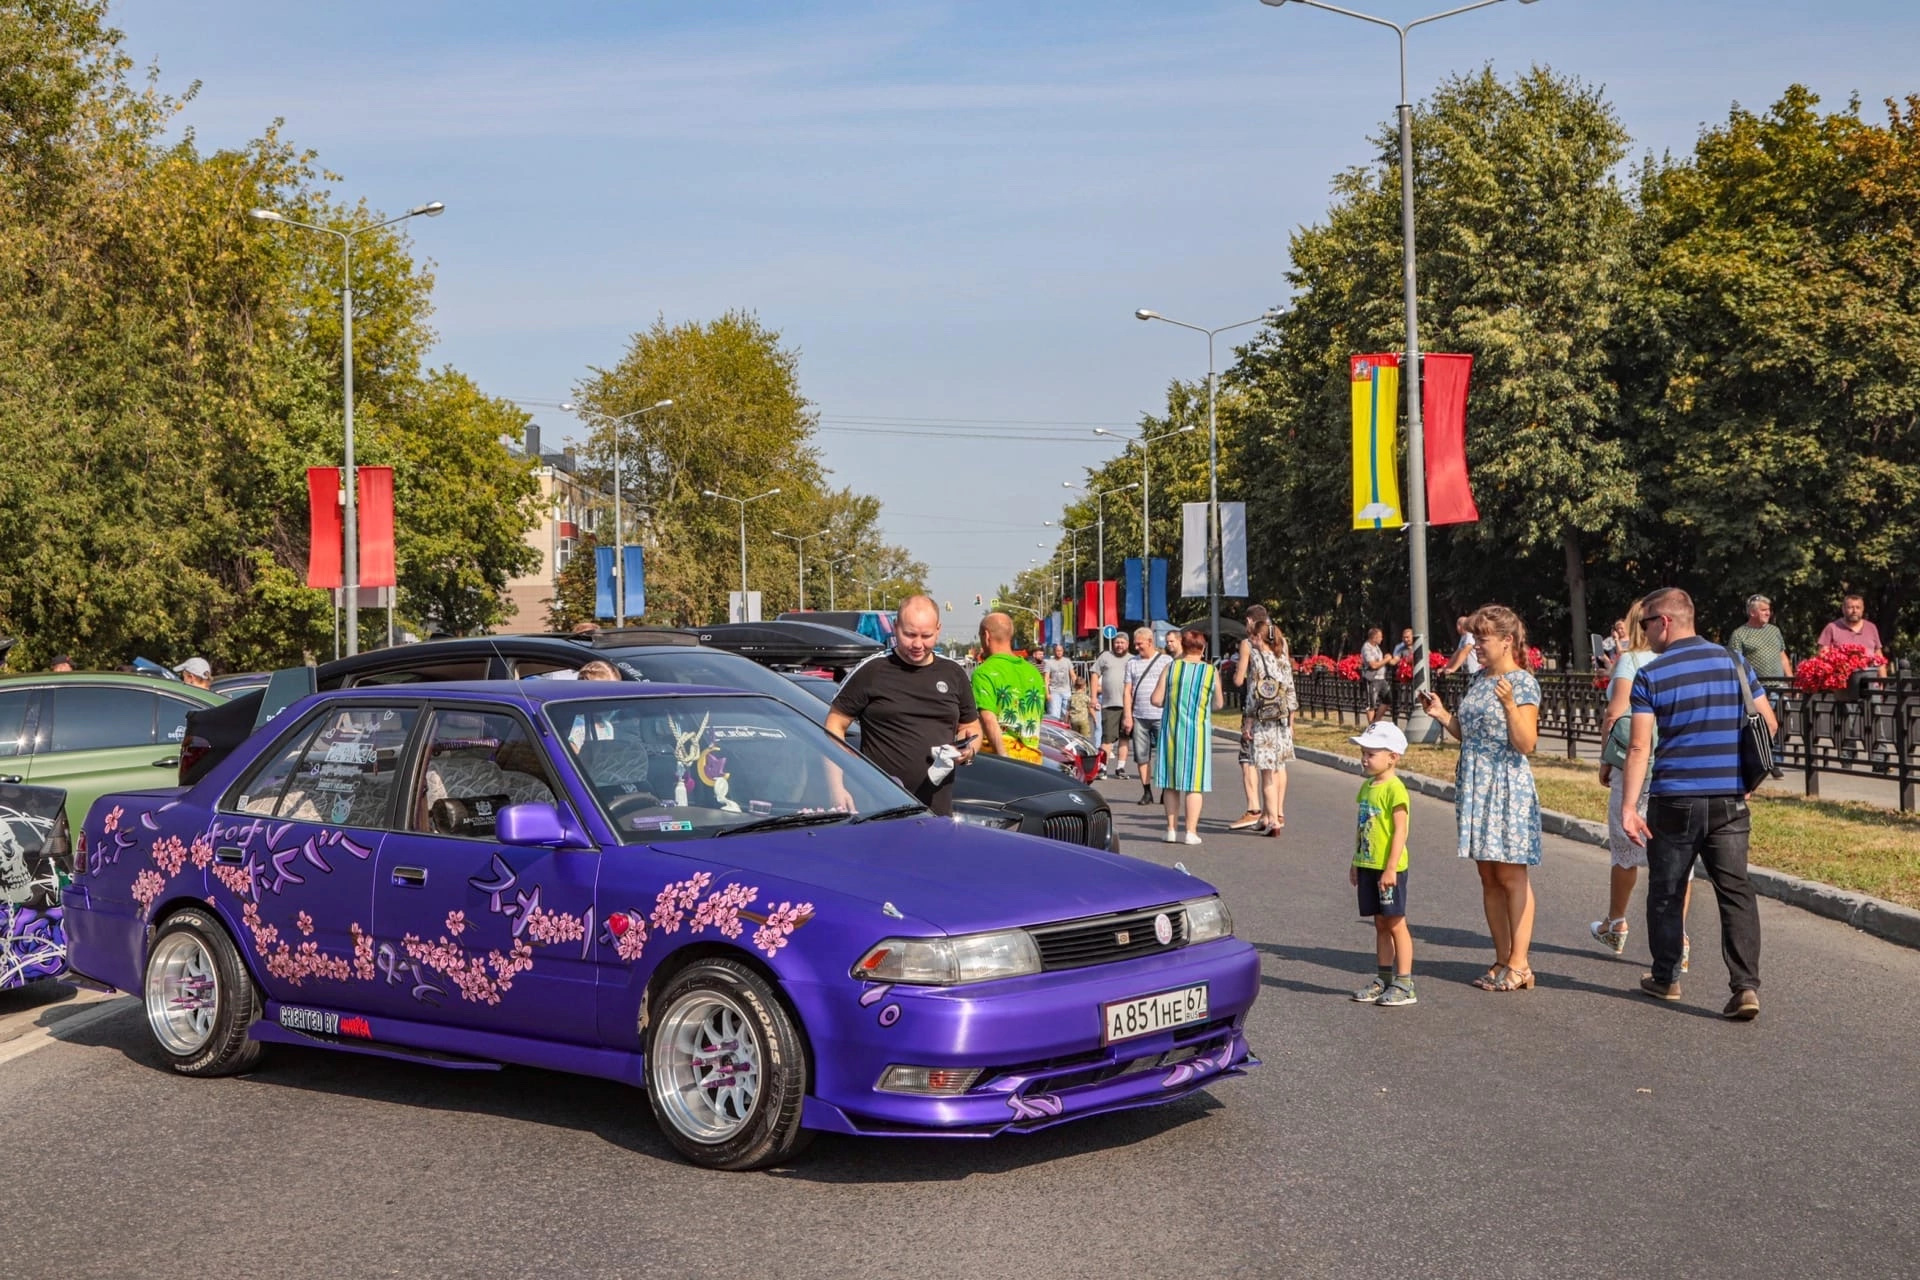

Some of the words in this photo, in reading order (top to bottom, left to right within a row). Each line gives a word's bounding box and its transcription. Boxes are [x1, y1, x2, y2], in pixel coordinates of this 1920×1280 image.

[168, 914, 202, 927] TOYO
[280, 1005, 323, 1033] CREATED
[324, 1012, 339, 1035] BY
[1113, 998, 1182, 1037] А851НЕ
[1187, 987, 1203, 1010] 67
[1186, 1011, 1198, 1019] RUS
[743, 990, 781, 1065] PROXES
[174, 1051, 214, 1070] PROXES
